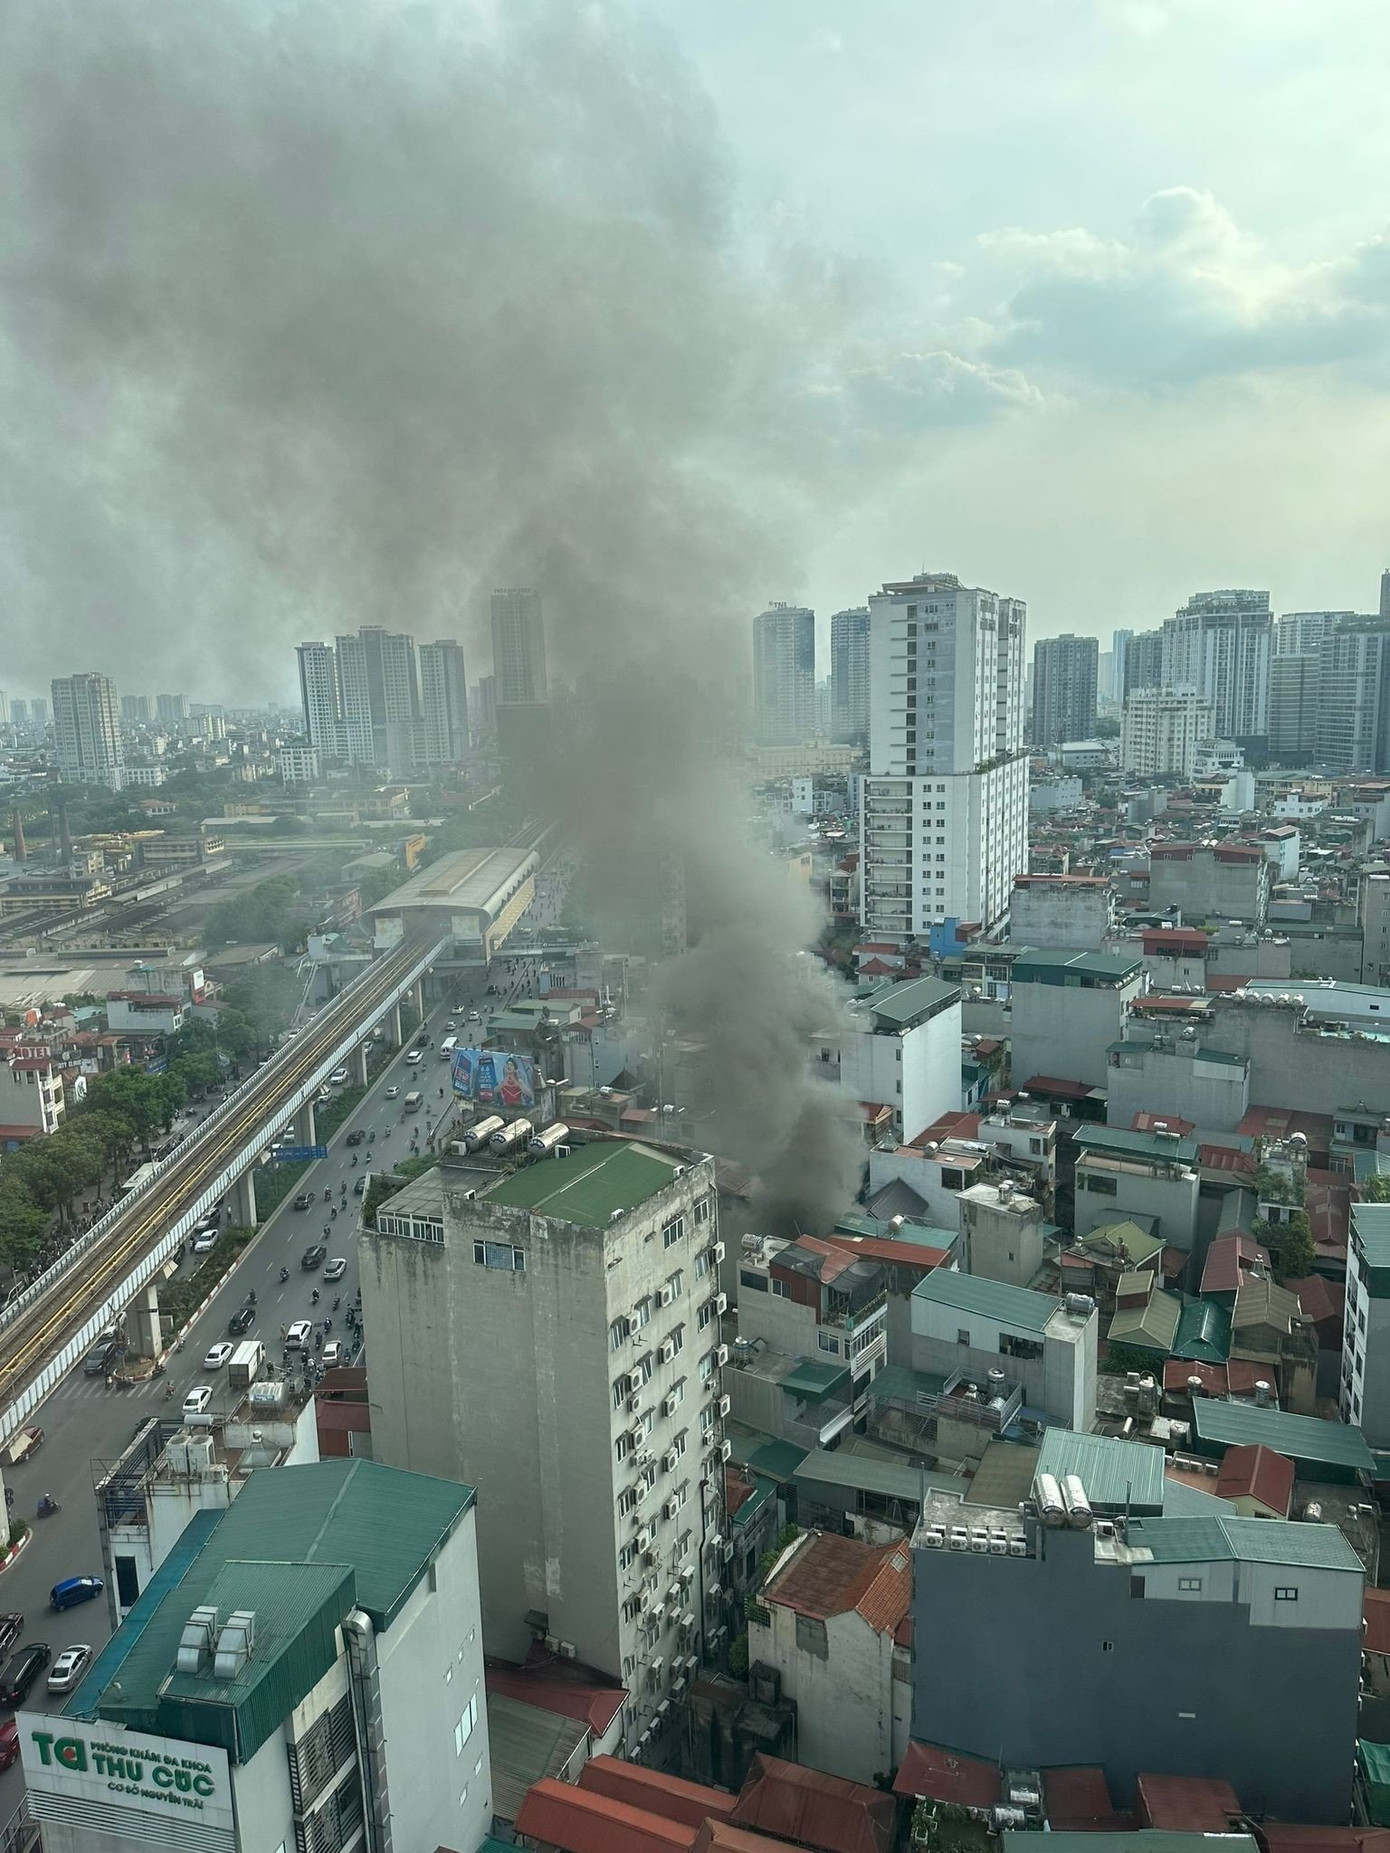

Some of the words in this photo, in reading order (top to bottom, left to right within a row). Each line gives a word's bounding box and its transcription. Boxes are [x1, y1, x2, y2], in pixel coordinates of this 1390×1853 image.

[92, 1753, 144, 1782] THU
[130, 1748, 162, 1763] KHÁM
[163, 1755, 180, 1767] ĐA
[181, 1758, 212, 1773] KHOA
